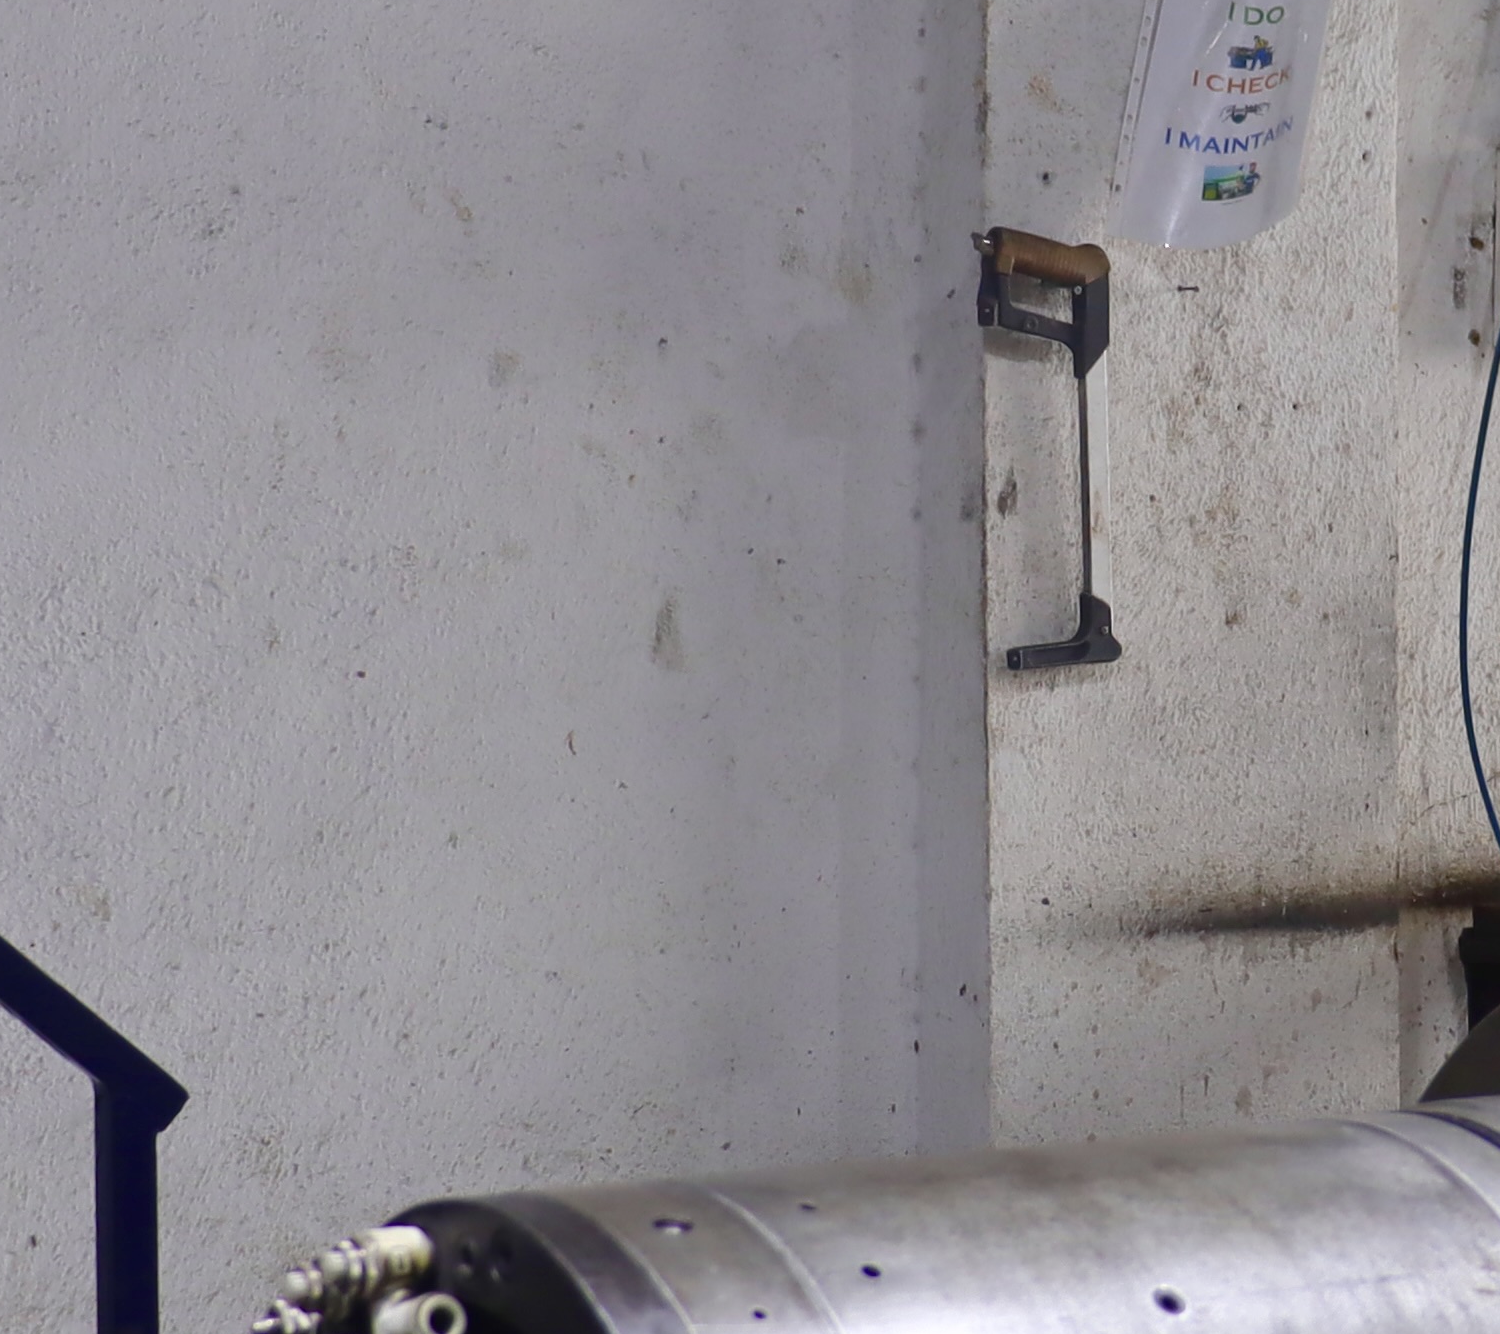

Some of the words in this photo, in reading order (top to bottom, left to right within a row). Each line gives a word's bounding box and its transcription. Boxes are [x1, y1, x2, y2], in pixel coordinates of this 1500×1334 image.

[1228, 1, 1235, 22] I
[1244, 5, 1285, 26] DO
[1192, 69, 1199, 87] I
[1206, 65, 1292, 95] CHECK
[1165, 127, 1172, 145] I
[1179, 117, 1294, 155] MAINTAIN
